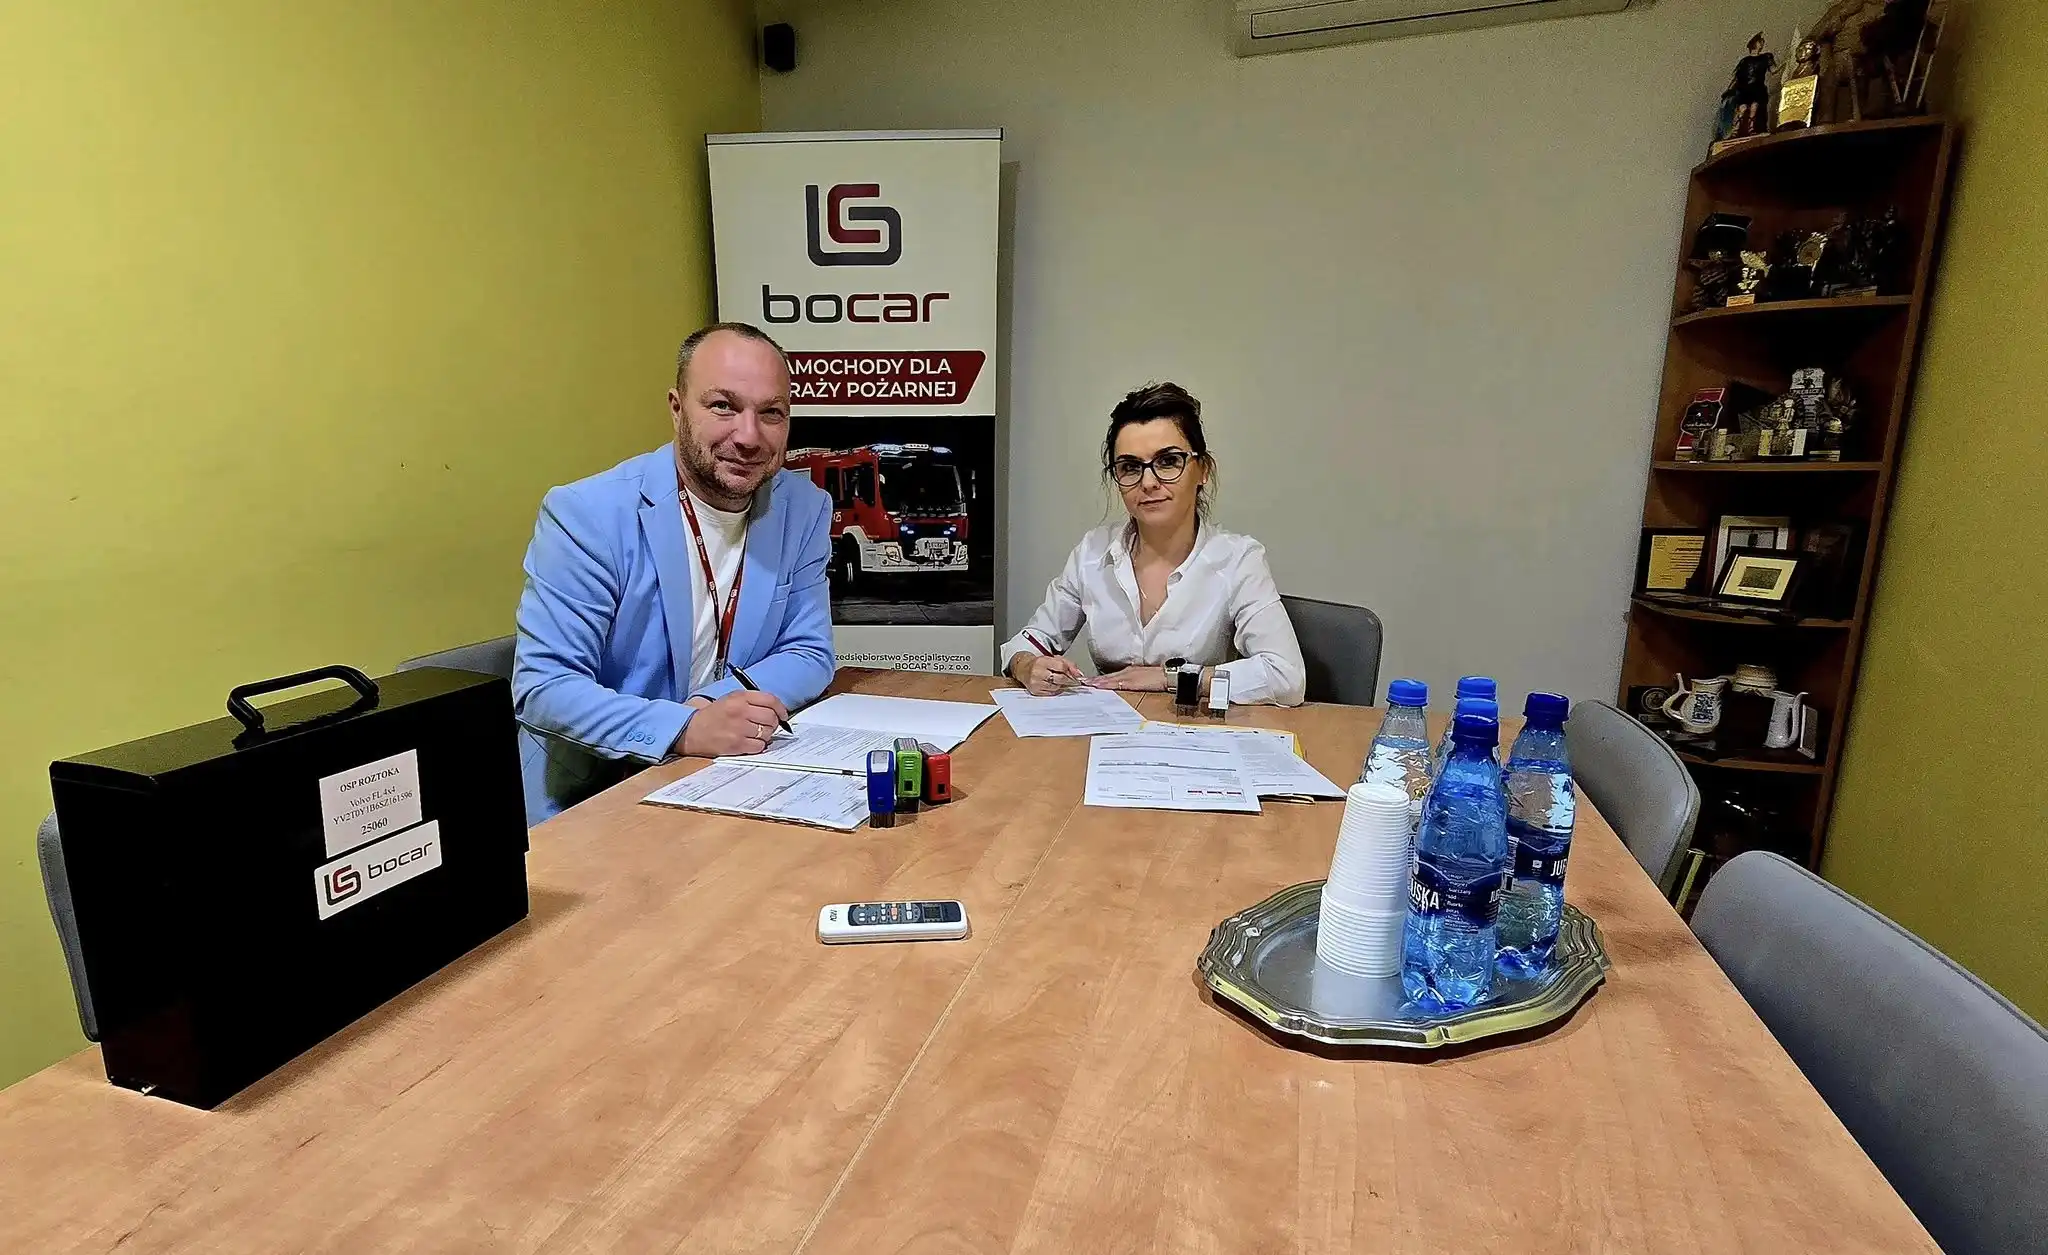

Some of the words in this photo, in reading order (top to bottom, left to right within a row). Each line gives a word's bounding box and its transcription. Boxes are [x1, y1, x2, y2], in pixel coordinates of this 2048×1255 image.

[762, 284, 950, 324] bocar
[786, 358, 904, 375] AMOCHODY
[910, 358, 952, 374] DLA
[789, 377, 841, 398] RAŻY
[847, 377, 957, 398] POŻARNEJ
[835, 653, 901, 663] zedsiębiorstwo
[902, 652, 971, 663] Specjalistyczne
[933, 663, 947, 672] Sp.
[340, 780, 357, 793] OSP
[358, 767, 400, 787] ROZTOKA
[349, 796, 371, 807] Volvo
[371, 790, 383, 801] FL
[383, 785, 396, 796] 4x4
[361, 817, 388, 835] 25060
[367, 841, 433, 880] bocar
